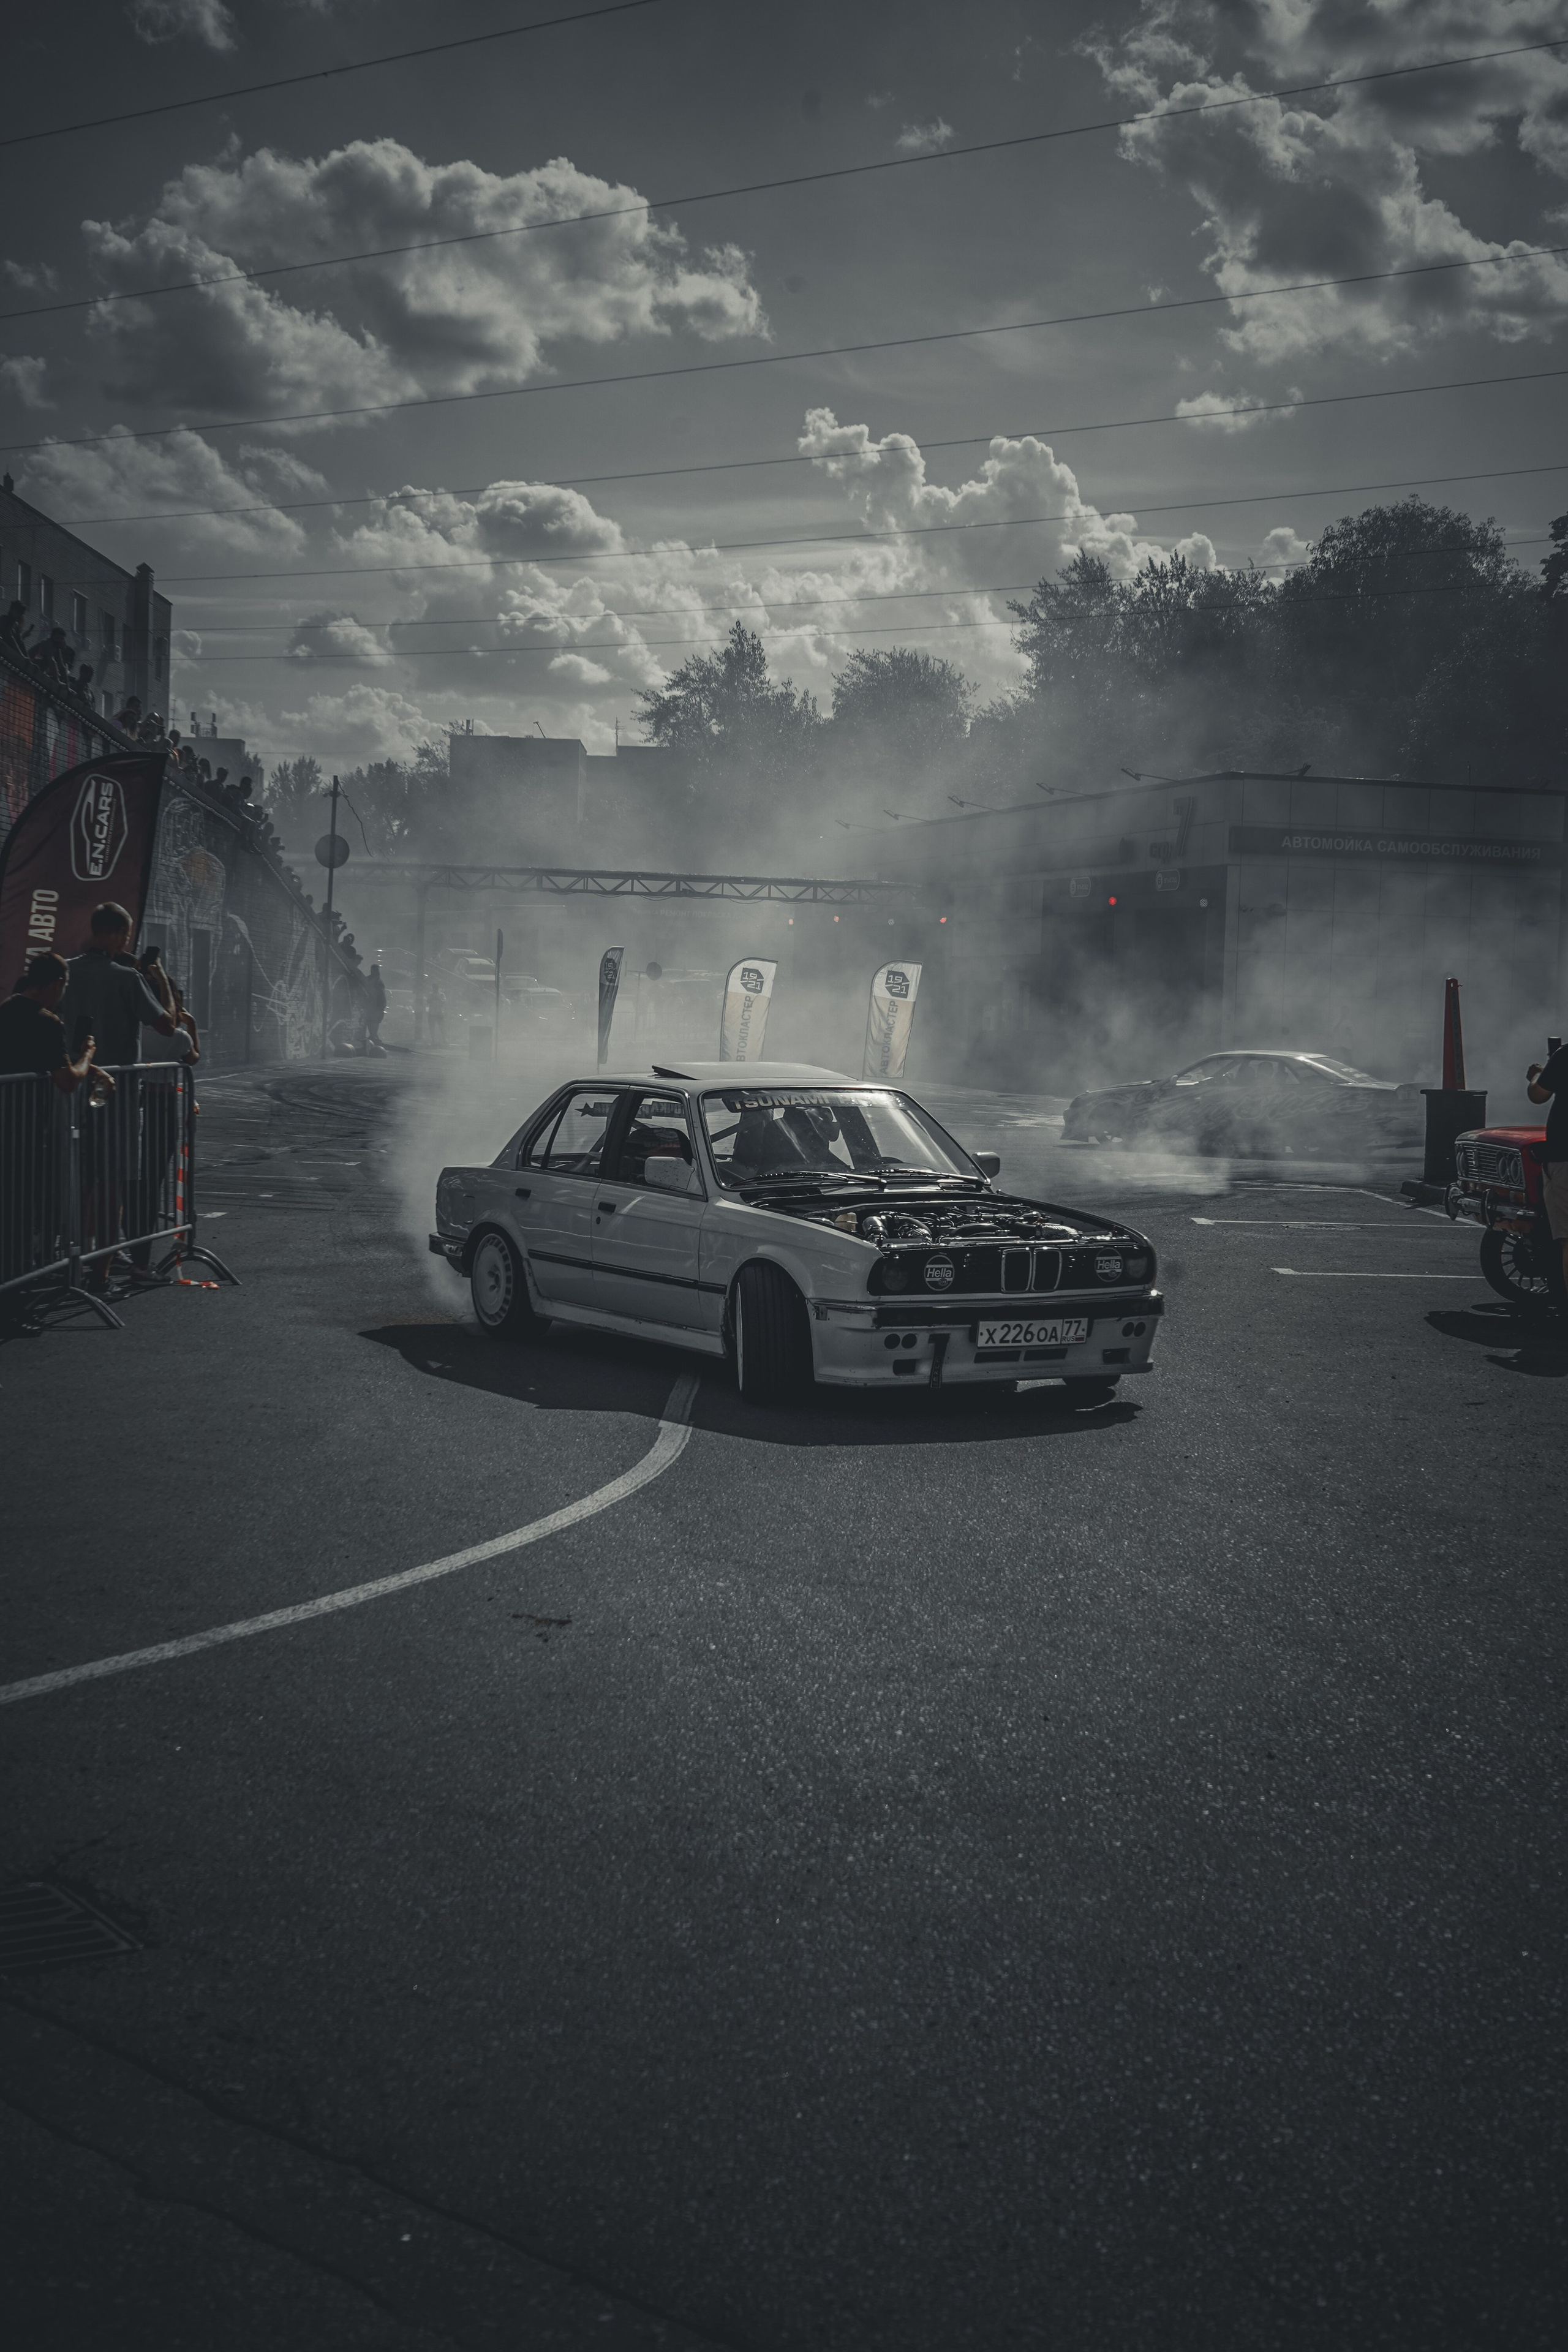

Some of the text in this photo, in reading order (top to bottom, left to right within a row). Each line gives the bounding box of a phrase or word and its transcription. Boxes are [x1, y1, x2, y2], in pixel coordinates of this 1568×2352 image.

[89, 782, 115, 876] E.N.CARS
[1281, 835, 1542, 860] АВТОМОЙКА САМООБСЛУЖИВАНИЯ
[28, 888, 59, 942] АВТО
[659, 908, 691, 918] РЕМОНТ
[887, 974, 903, 984] 19
[891, 985, 907, 994] 21
[736, 995, 754, 1062] ВТОКЛАСТЕР
[879, 1000, 899, 1076] АВТОКЛАСТЕР
[730, 1094, 831, 1110] TSUNAMI
[927, 1267, 952, 1278] Hella
[1097, 1259, 1121, 1270] Hella
[1065, 1319, 1082, 1336] 77
